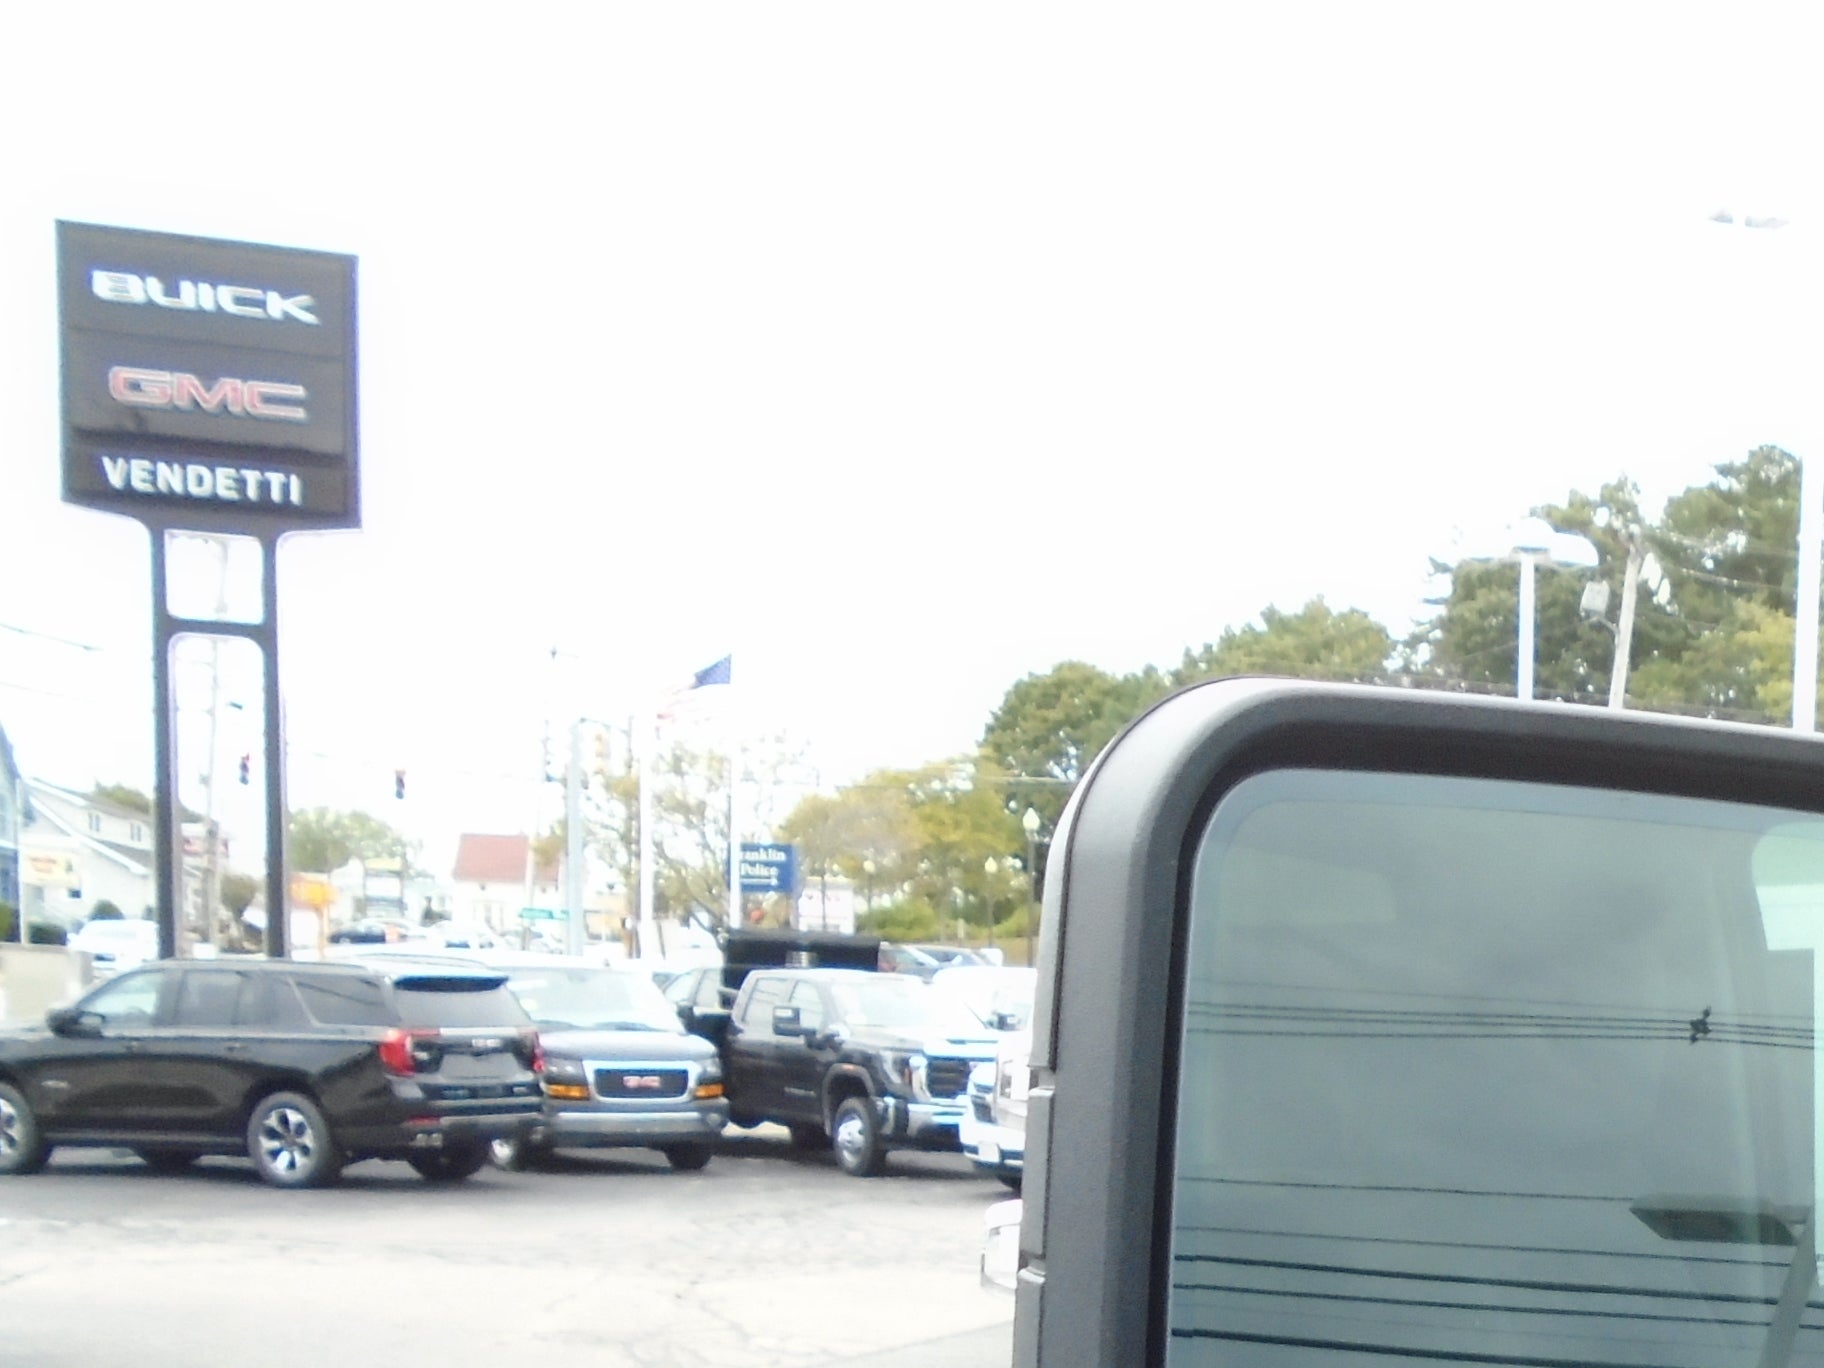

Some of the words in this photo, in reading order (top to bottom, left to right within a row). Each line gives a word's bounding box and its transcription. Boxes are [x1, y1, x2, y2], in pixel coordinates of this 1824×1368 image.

[91, 269, 320, 325] BUICK
[108, 366, 307, 419] GMC
[101, 456, 302, 506] VENDETTI
[738, 848, 786, 861] ranklin
